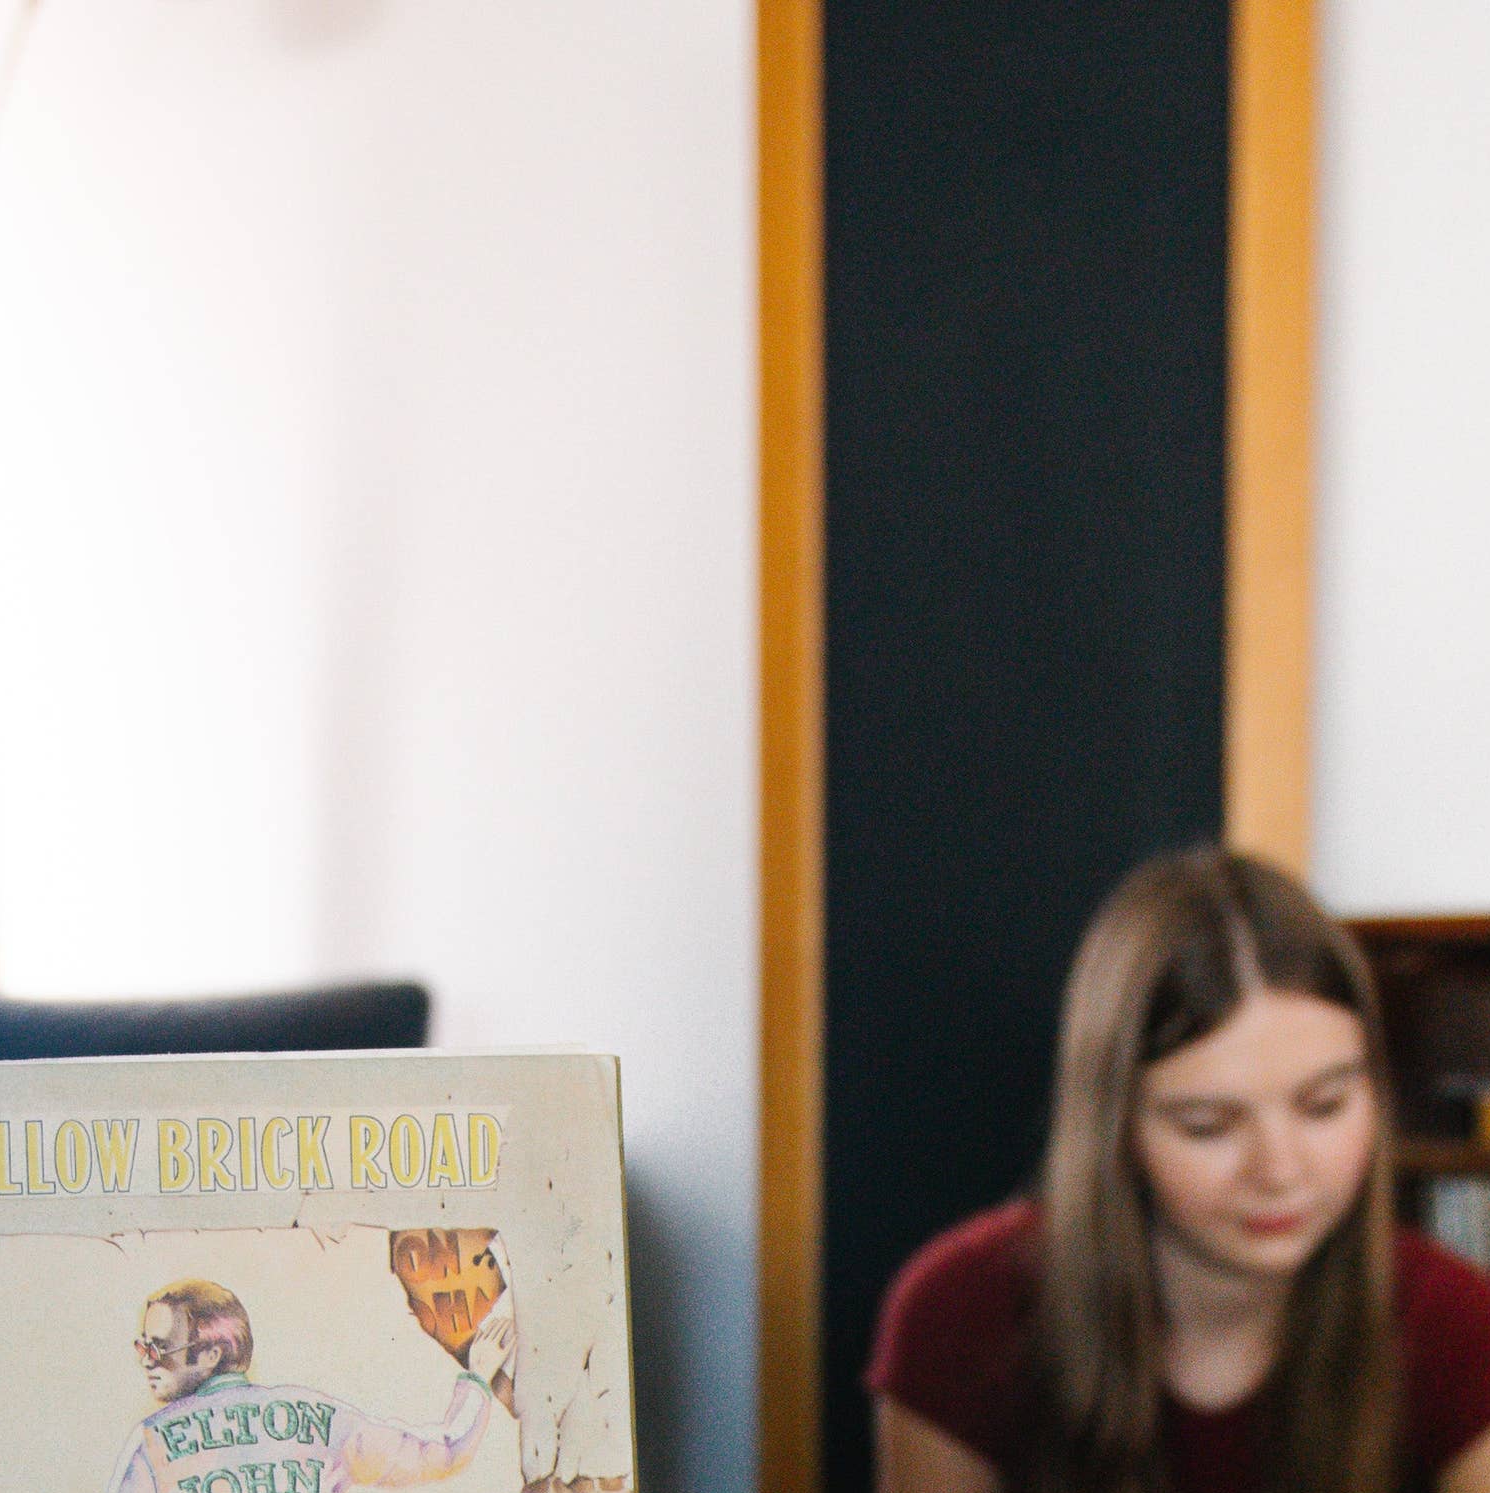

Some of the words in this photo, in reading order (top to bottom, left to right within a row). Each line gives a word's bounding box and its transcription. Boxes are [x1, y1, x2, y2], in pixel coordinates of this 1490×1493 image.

[157, 1115, 334, 1194] BRICK
[349, 1113, 504, 1190] ROAD
[154, 1400, 337, 1463] ELTON
